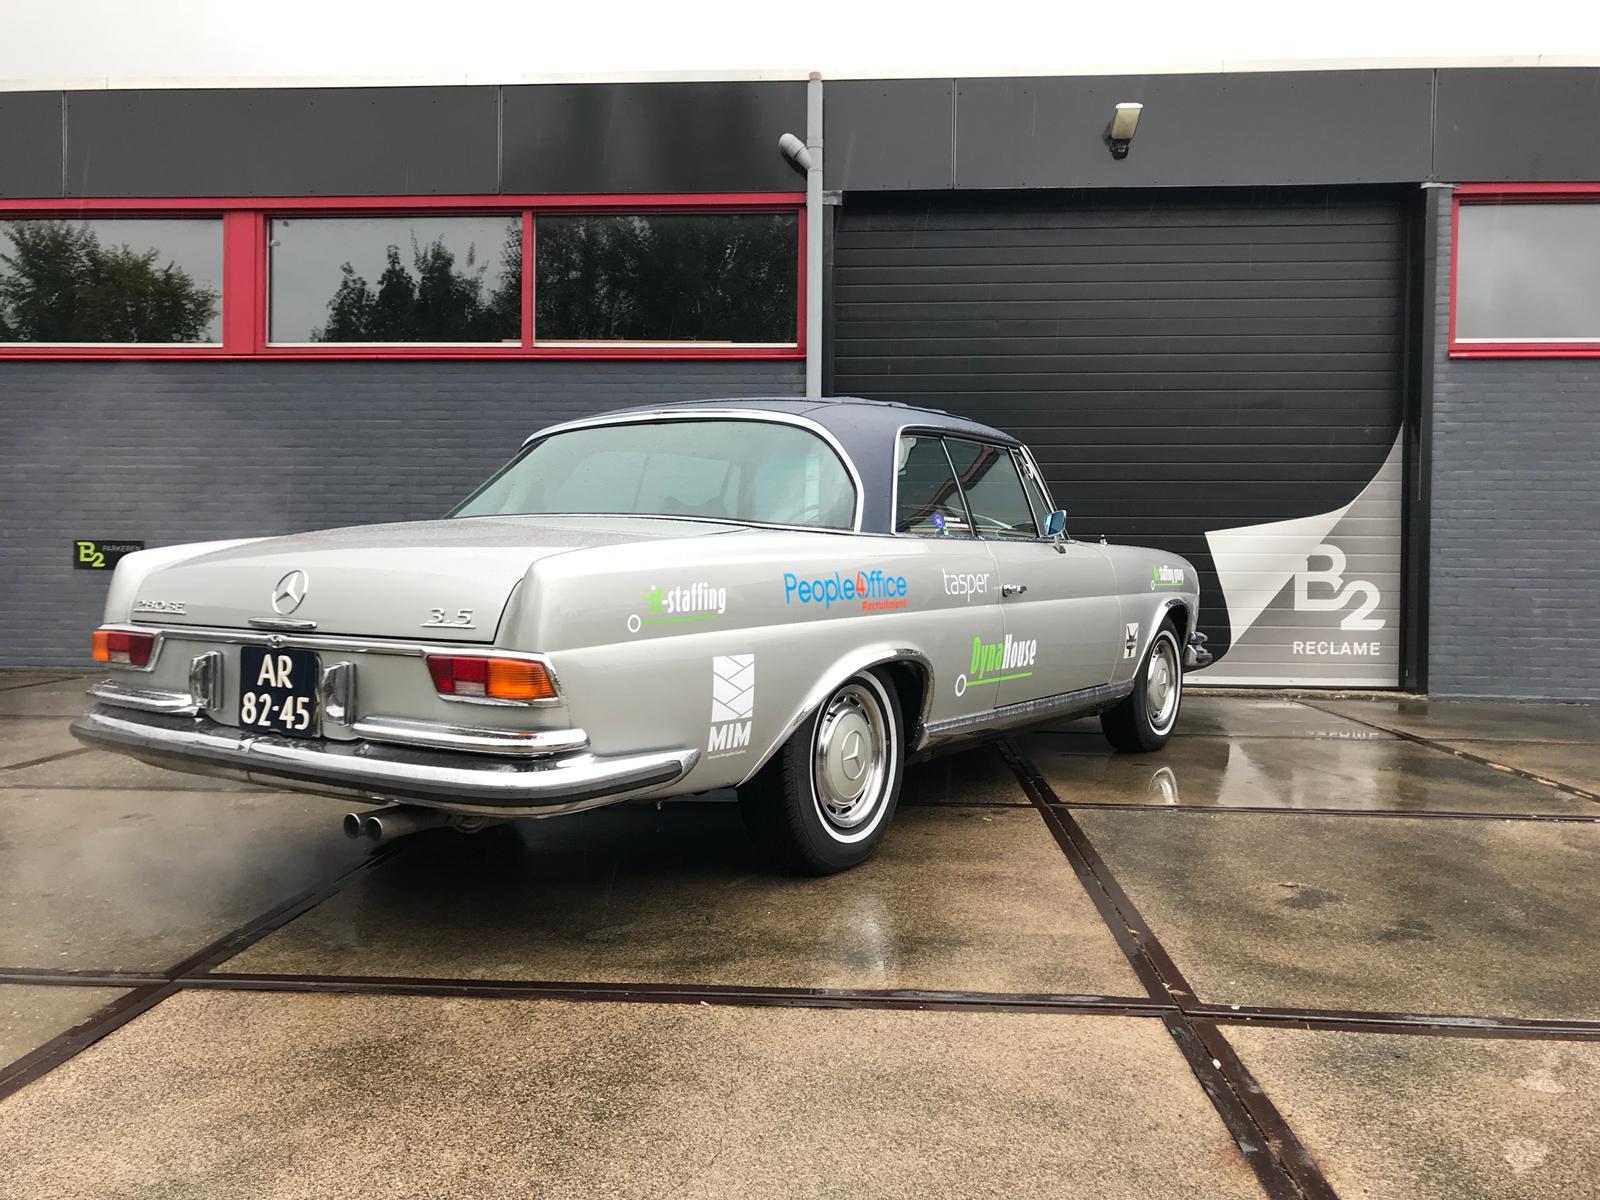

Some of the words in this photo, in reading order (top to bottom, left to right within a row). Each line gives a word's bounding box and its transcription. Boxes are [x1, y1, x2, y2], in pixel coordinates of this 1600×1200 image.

[77, 541, 106, 567] B2
[942, 568, 990, 603] tasper
[1294, 543, 1386, 631] B2
[426, 607, 473, 625] 3.5
[862, 598, 908, 612] Recruitment
[969, 633, 1037, 680] DynaHouse
[1292, 641, 1381, 656] RECLAME
[256, 653, 294, 689] AR
[241, 692, 311, 731] 82-45
[707, 720, 752, 752] MIM
